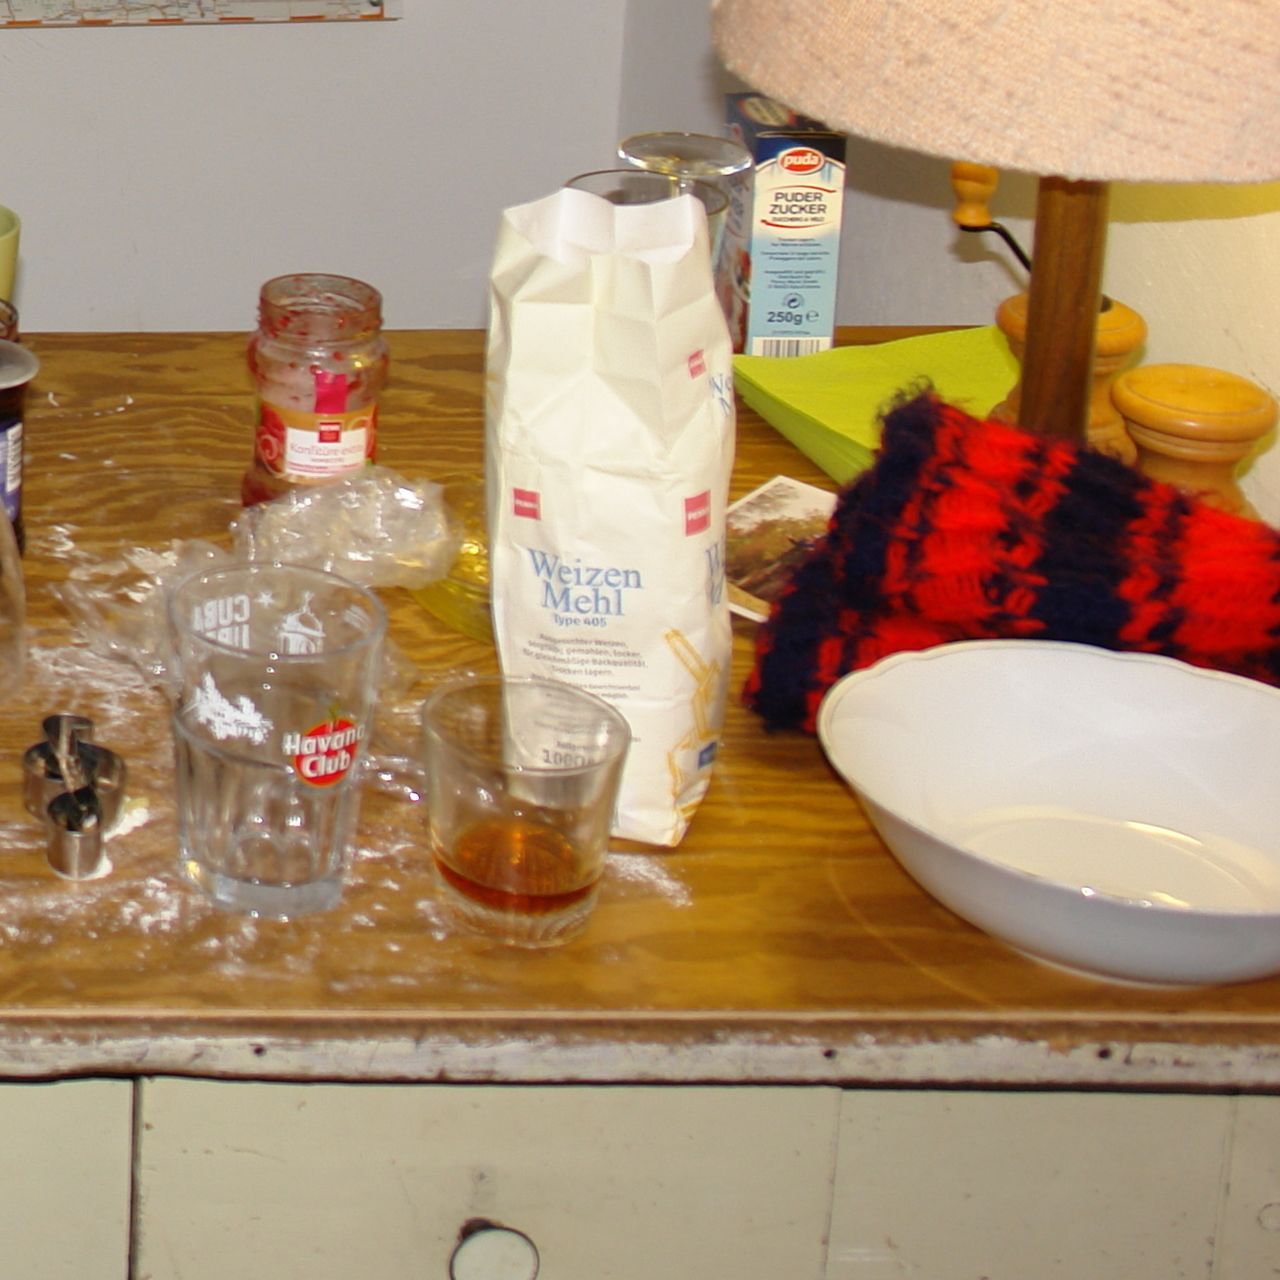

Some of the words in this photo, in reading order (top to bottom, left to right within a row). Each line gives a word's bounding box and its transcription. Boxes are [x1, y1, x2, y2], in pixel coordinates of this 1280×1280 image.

[783, 153, 820, 168] puda
[774, 192, 823, 203] PUDER
[769, 204, 827, 215] ZUCKER
[767, 311, 803, 326] 250g
[527, 548, 645, 589] Weizen
[541, 579, 624, 616] Mehl
[554, 614, 581, 627] Type
[583, 617, 607, 627] 405
[283, 724, 366, 756] Havana
[301, 750, 351, 778] Club
